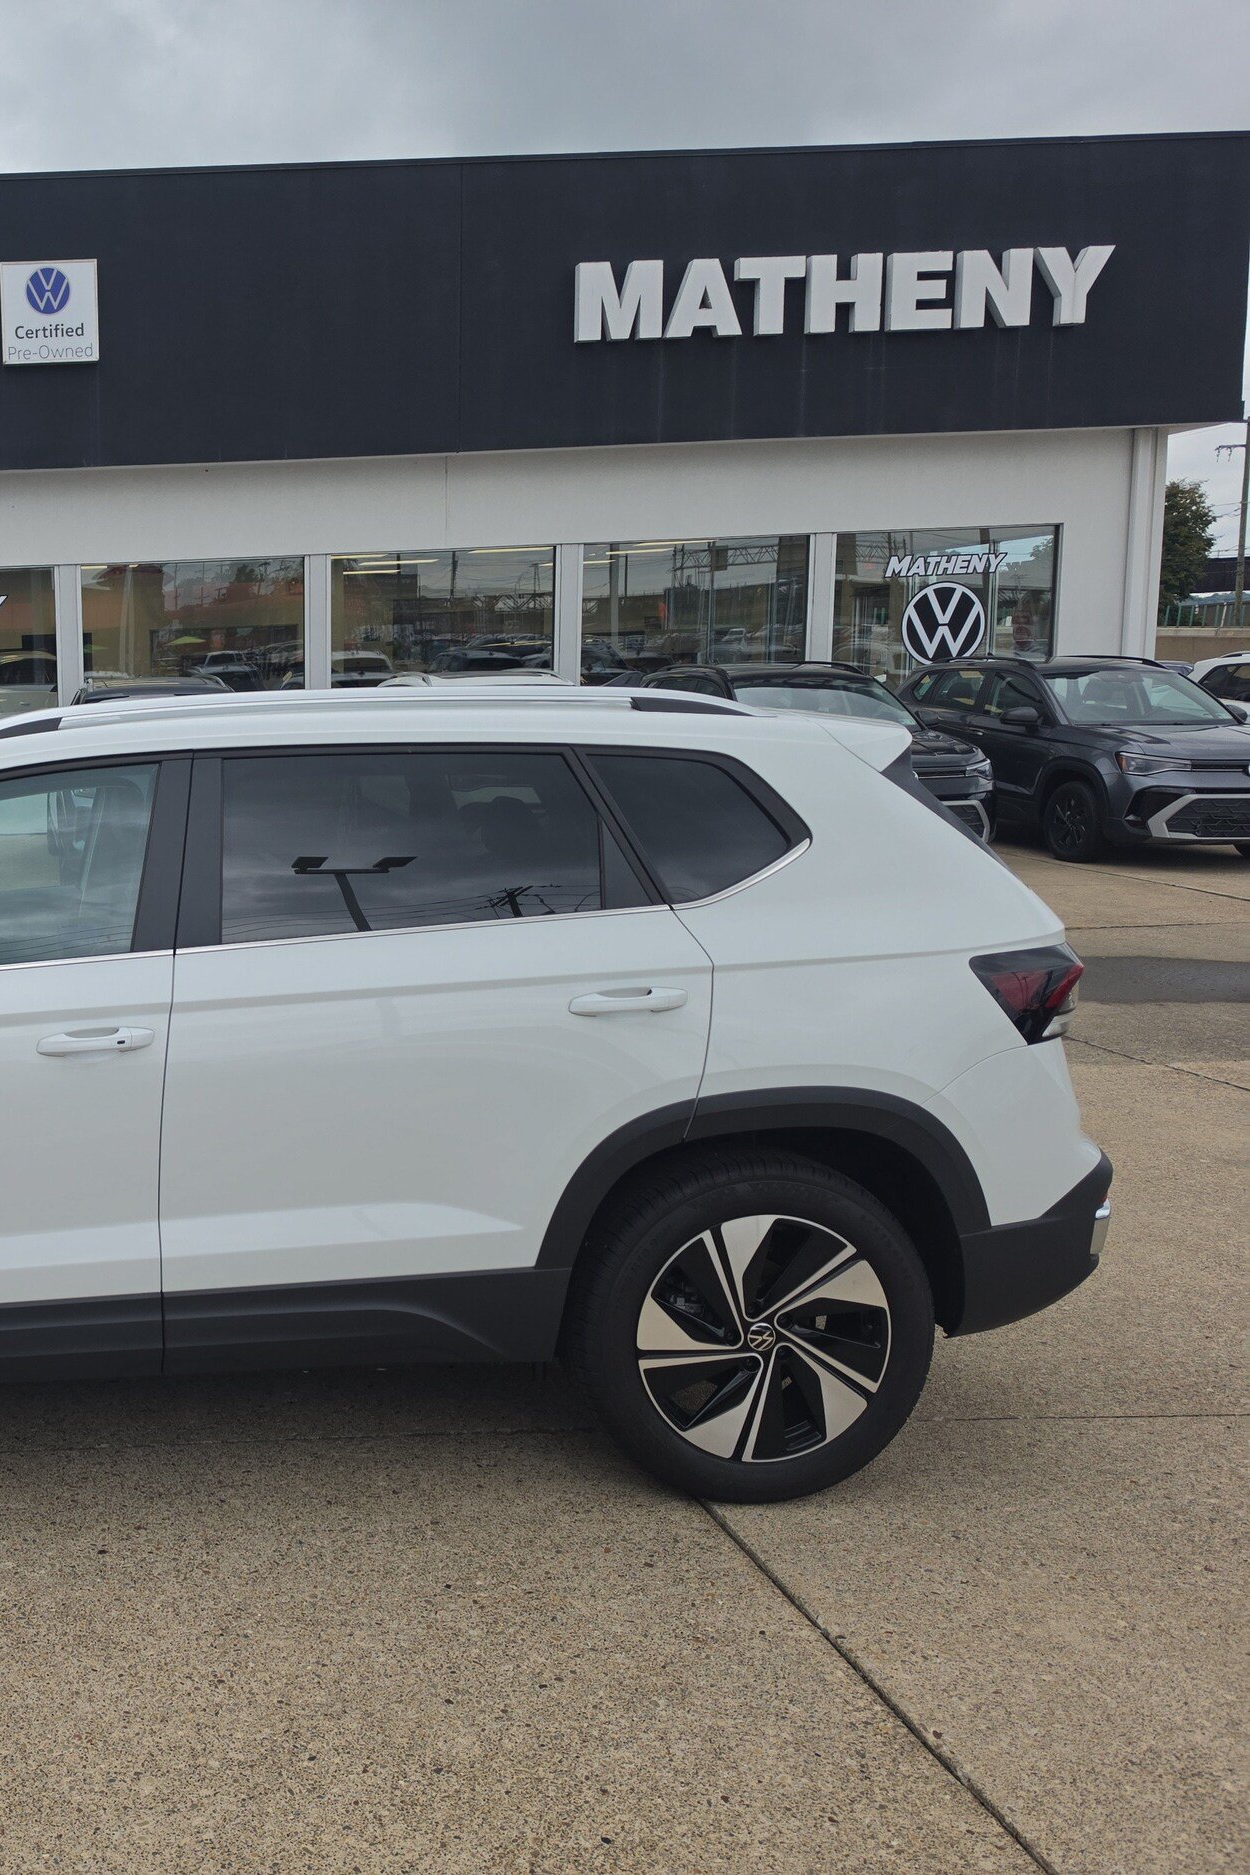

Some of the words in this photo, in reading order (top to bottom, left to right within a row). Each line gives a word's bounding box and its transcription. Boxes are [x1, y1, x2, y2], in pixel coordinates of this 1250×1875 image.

[574, 244, 1116, 343] MATHENY
[14, 322, 85, 340] Certified
[7, 343, 94, 361] Pre-Owned
[885, 552, 1008, 578] MATHENY
